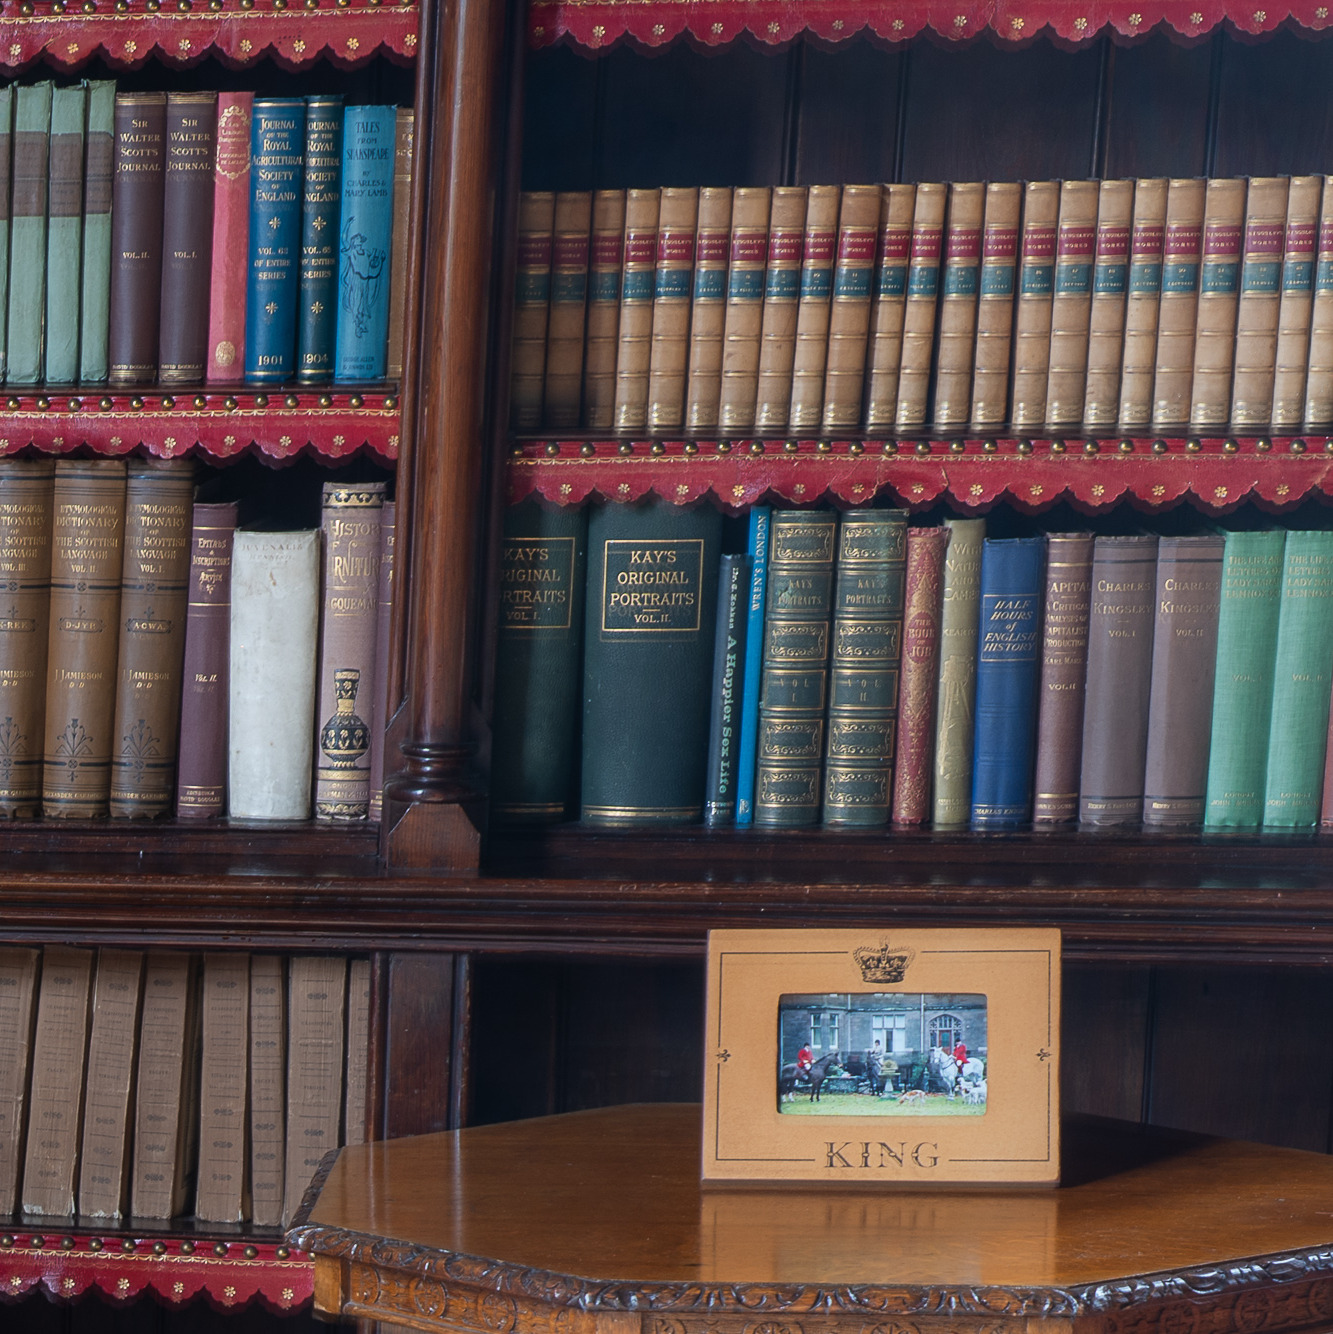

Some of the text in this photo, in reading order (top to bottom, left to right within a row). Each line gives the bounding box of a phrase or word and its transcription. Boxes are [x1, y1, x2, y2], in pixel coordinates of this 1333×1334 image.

[132, 119, 148, 128] SIR
[182, 118, 198, 127] SIR
[261, 118, 297, 132] JOURNAL
[356, 121, 380, 133] TALES
[120, 133, 160, 142] WALTER
[170, 132, 210, 142] WALTER
[263, 140, 292, 151] ROYAL
[117, 161, 160, 173] JOURNAL
[167, 161, 211, 173] JOURNAL
[259, 171, 293, 182] SOCIETY
[256, 191, 296, 202] ENGLAND
[258, 271, 286, 280] SERIES
[258, 354, 283, 366] 1901
[302, 353, 329, 365] 1904
[60, 504, 117, 515] ETYMOLOGICAL
[56, 516, 118, 530] DICTIONARY
[56, 537, 118, 548] THE SCOTTISH
[504, 548, 549, 561] KAY'S
[630, 551, 676, 564] KAY'S
[751, 515, 768, 611] WREN'S LONDON
[617, 571, 689, 585] ORIGINAL
[1097, 579, 1151, 592] CHARLES
[1164, 578, 1219, 592] CHARLES
[609, 593, 694, 607] PORTRAITS
[994, 600, 1031, 610] HALF
[1094, 602, 1152, 614] KINGSLEY
[1160, 600, 1220, 614] KINGSLEY
[990, 610, 1033, 621] HOURS
[984, 631, 1036, 642] ENGLISH
[983, 642, 1035, 652] HISTORY
[721, 653, 737, 723] Happier
[720, 727, 733, 757] Sex
[718, 759, 731, 795] Life
[823, 1141, 941, 1169] KING
